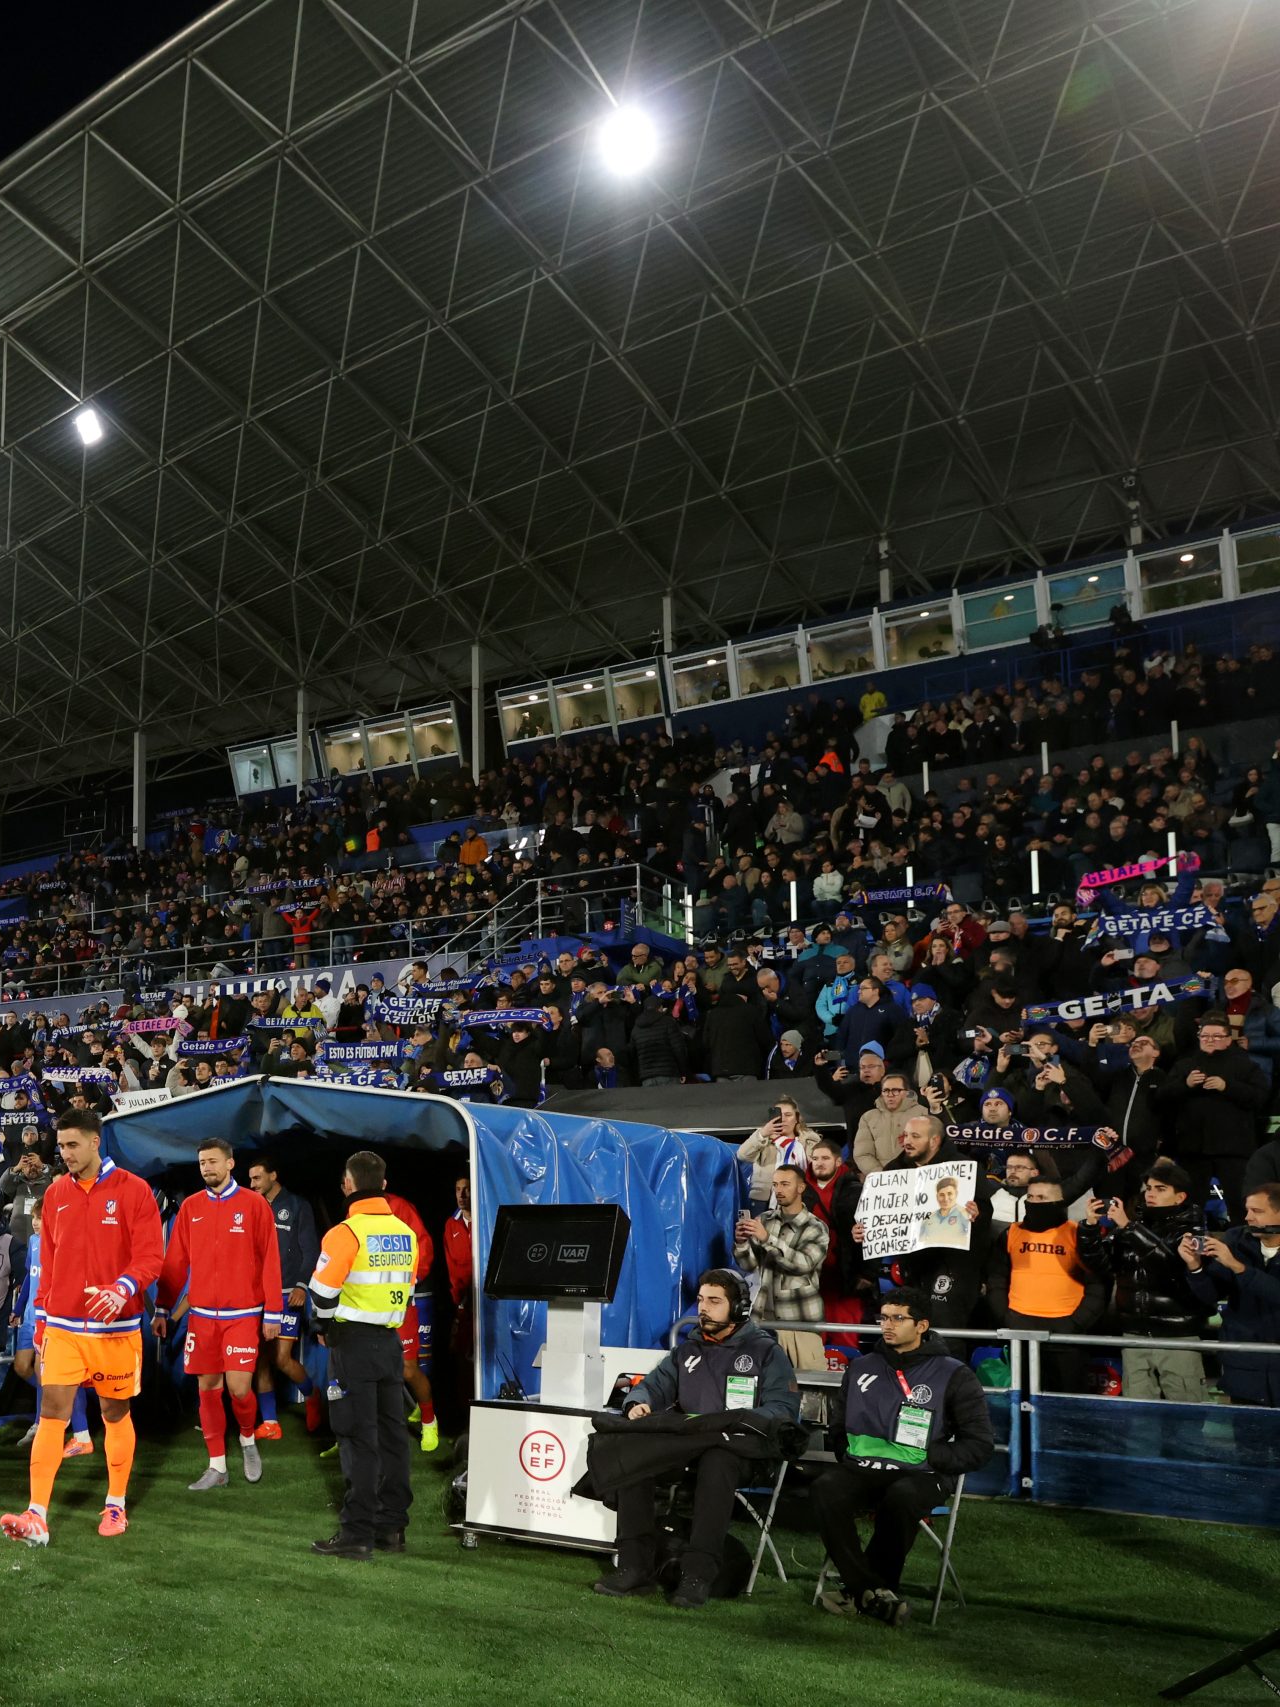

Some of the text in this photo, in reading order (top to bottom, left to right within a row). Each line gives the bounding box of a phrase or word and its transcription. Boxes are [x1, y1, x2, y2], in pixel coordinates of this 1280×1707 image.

[868, 888, 911, 900] GETAFE
[1105, 910, 1206, 932] GETAFE CF
[140, 991, 167, 1001] GETAFE
[389, 997, 442, 1009] GETAFE
[265, 1017, 296, 1026] GETAFE
[467, 1010, 506, 1022] Getafe
[129, 1018, 177, 1031] GETAFE CF
[181, 1040, 215, 1051] Getafe
[329, 1041, 399, 1059] ESTO ES FÚTBOL PAPÁ
[51, 1068, 93, 1081] GETAFE
[357, 1073, 377, 1086] CF
[444, 1067, 488, 1081] GETAFE
[128, 1097, 157, 1109] JULIAN
[945, 1124, 1083, 1141] Getafe C.F.
[873, 1192, 909, 1210] MUJER
[915, 1192, 928, 1206] NO
[866, 1227, 888, 1243] CASA
[381, 1236, 410, 1250] GSI
[1019, 1240, 1067, 1256] Joma
[563, 1248, 585, 1258] VAR
[389, 1290, 404, 1305] 38
[530, 1488, 551, 1496] REAL
